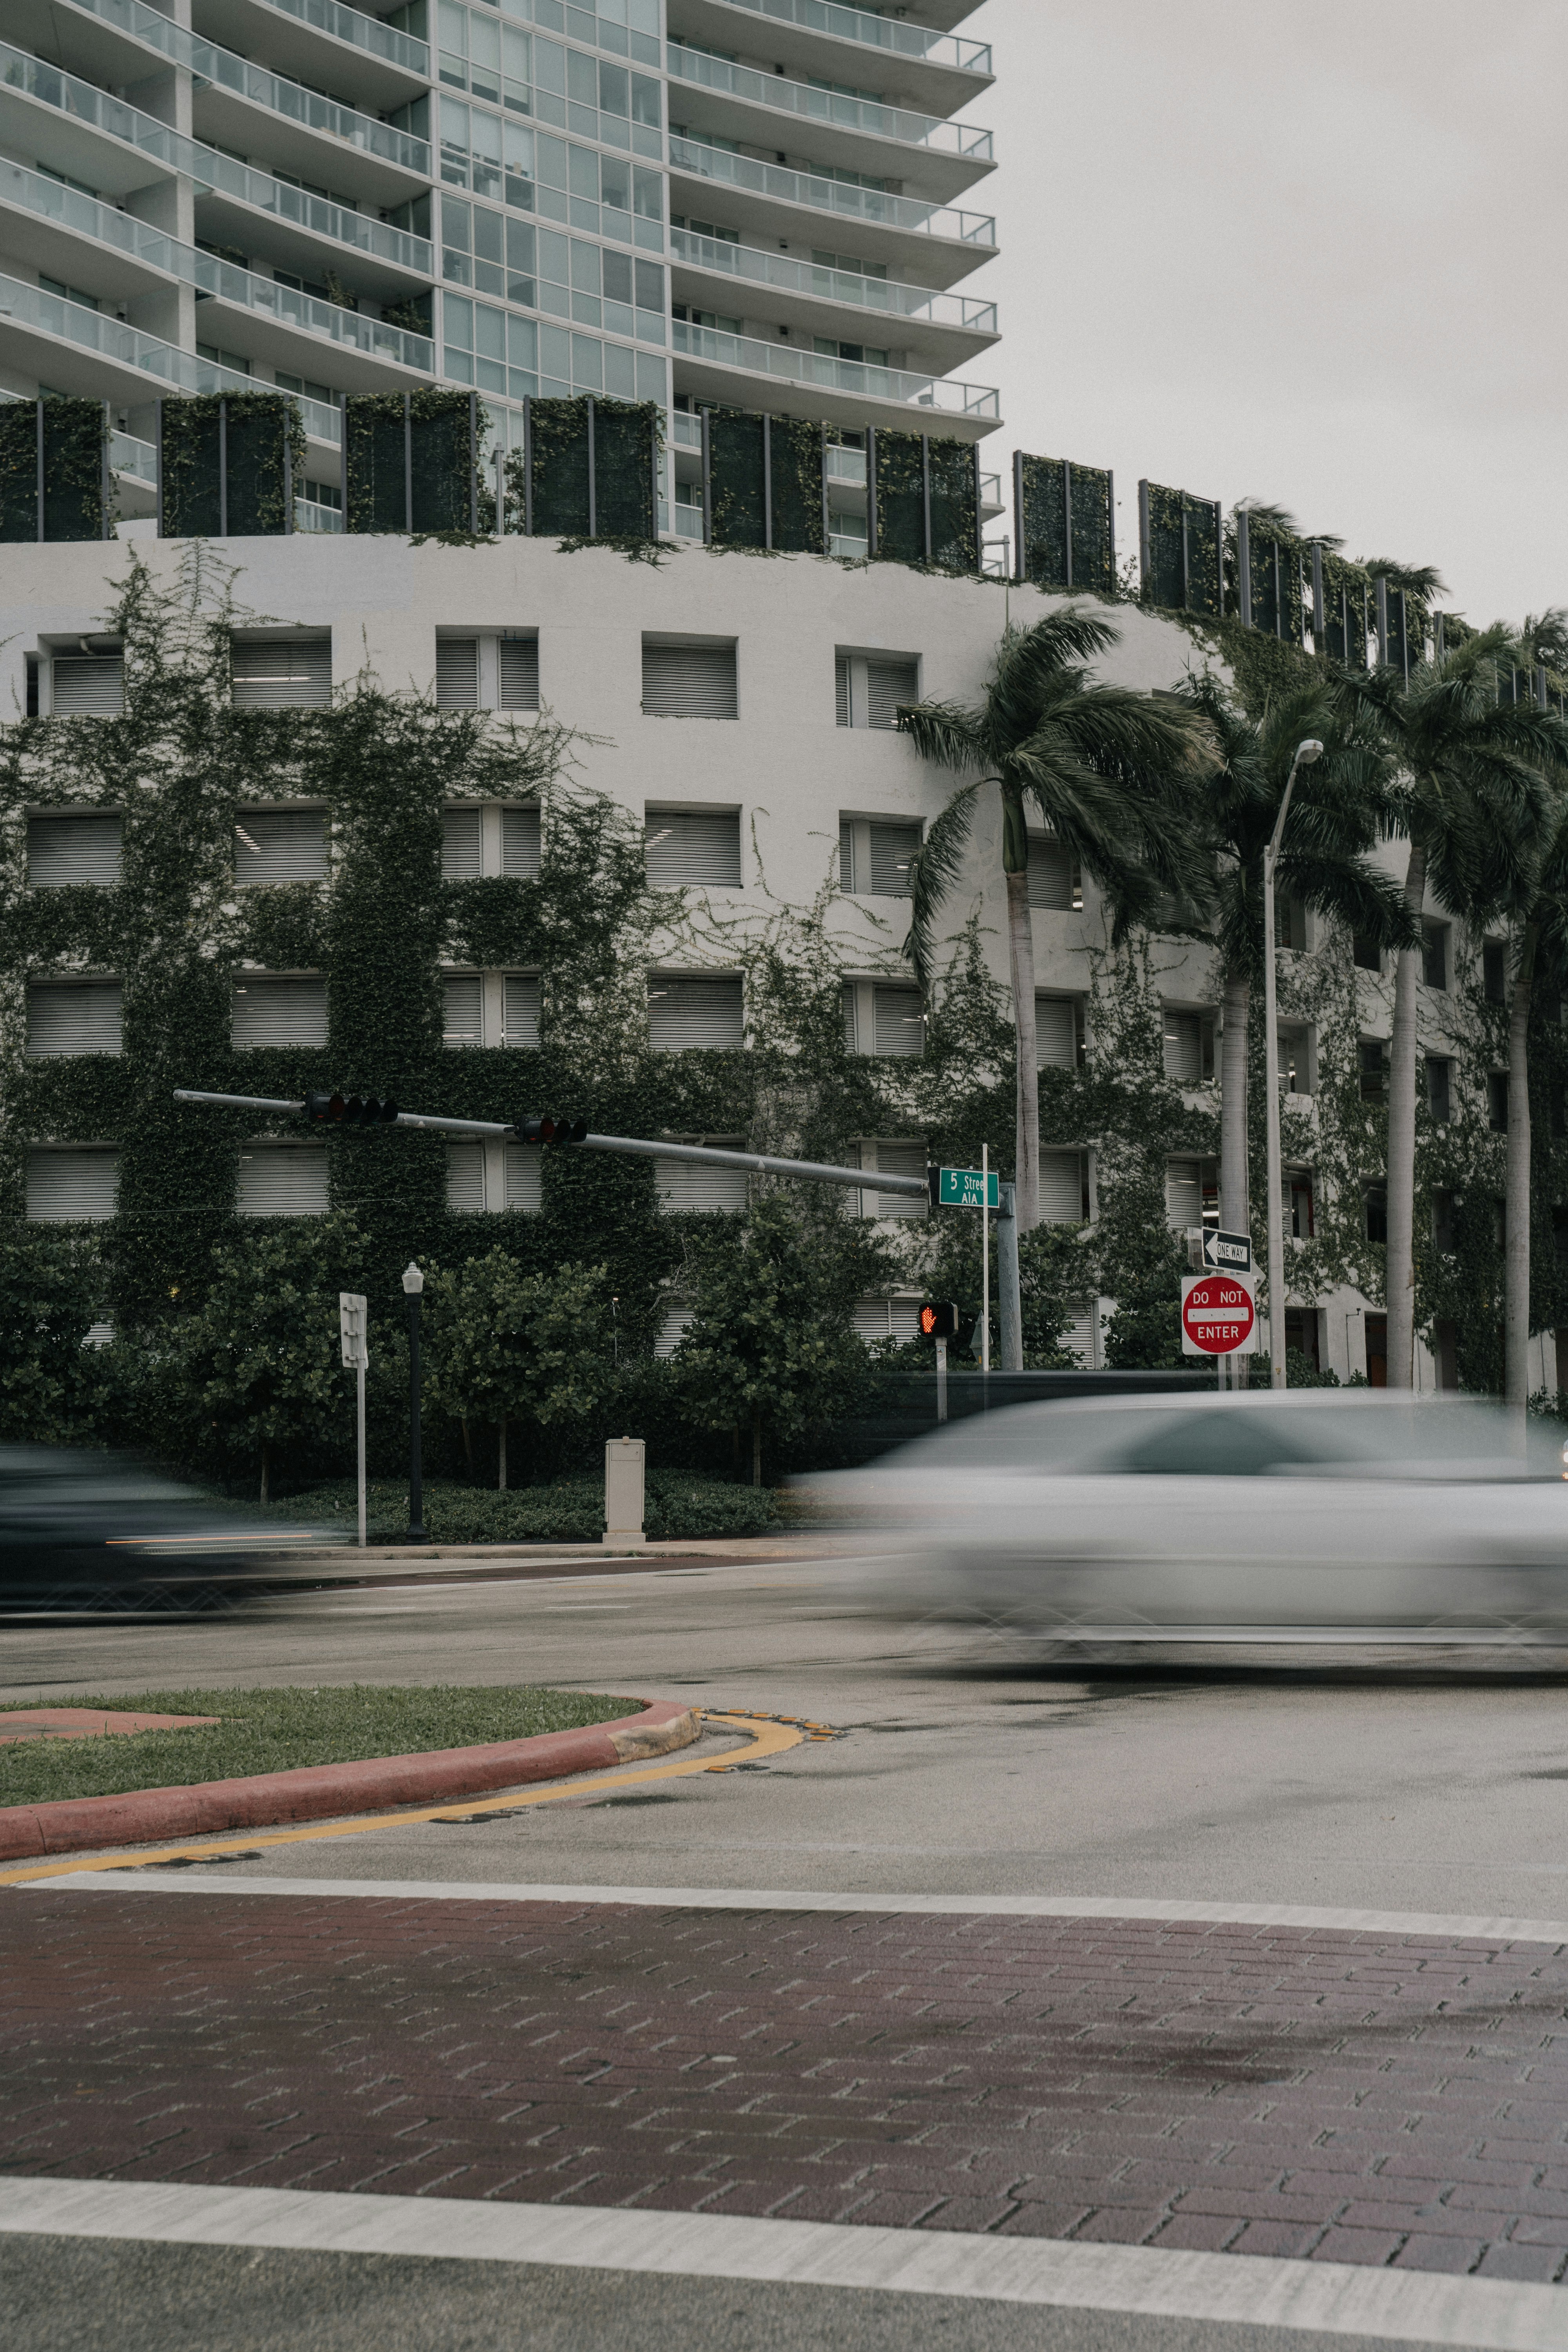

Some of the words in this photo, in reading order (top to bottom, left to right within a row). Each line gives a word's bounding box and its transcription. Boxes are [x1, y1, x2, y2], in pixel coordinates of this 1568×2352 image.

[951, 1172, 957, 1190] 5
[964, 1175, 984, 1191] Stree
[961, 1191, 978, 1204] A1A
[1217, 1243, 1229, 1257] ONE
[1231, 1246, 1243, 1259] WAY
[1193, 1292, 1209, 1304] DO
[1220, 1290, 1243, 1303] NOT
[1198, 1326, 1239, 1339] ENTER
